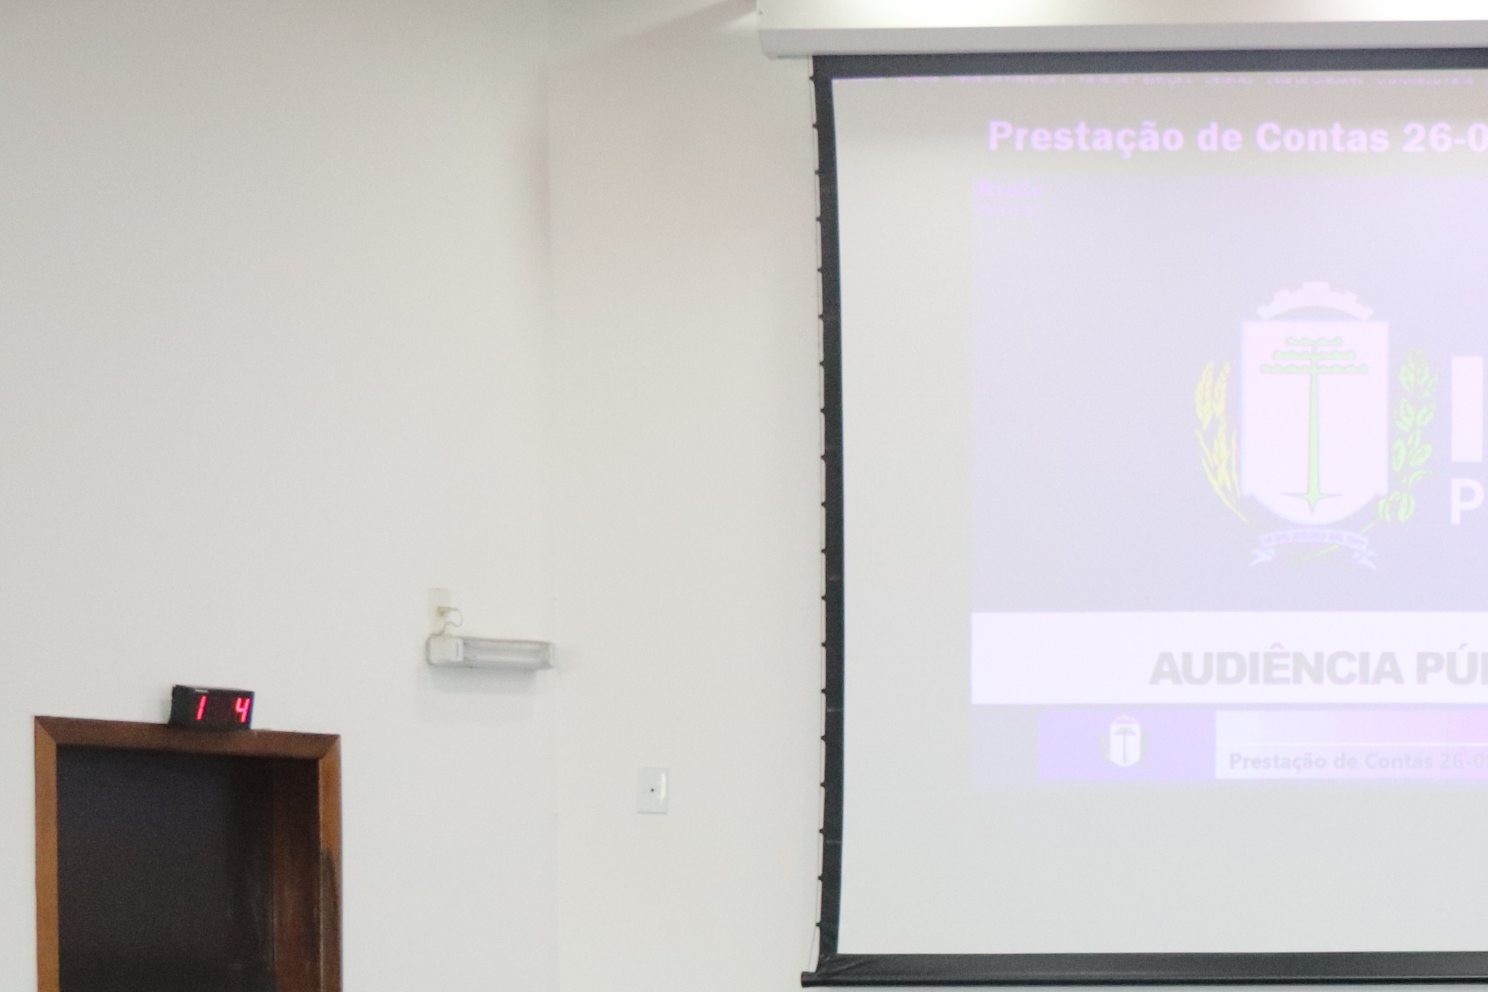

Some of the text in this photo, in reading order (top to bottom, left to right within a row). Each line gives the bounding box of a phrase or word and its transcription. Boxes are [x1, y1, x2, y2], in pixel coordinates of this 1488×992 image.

[987, 119, 1184, 157] Prestação
[1196, 122, 1243, 153] de
[1256, 122, 1389, 154] Contas
[1148, 643, 1404, 686] AUDIÊNCIA
[1229, 752, 1327, 773] Prestação
[1333, 752, 1358, 769] de
[1365, 753, 1433, 769] Contas
